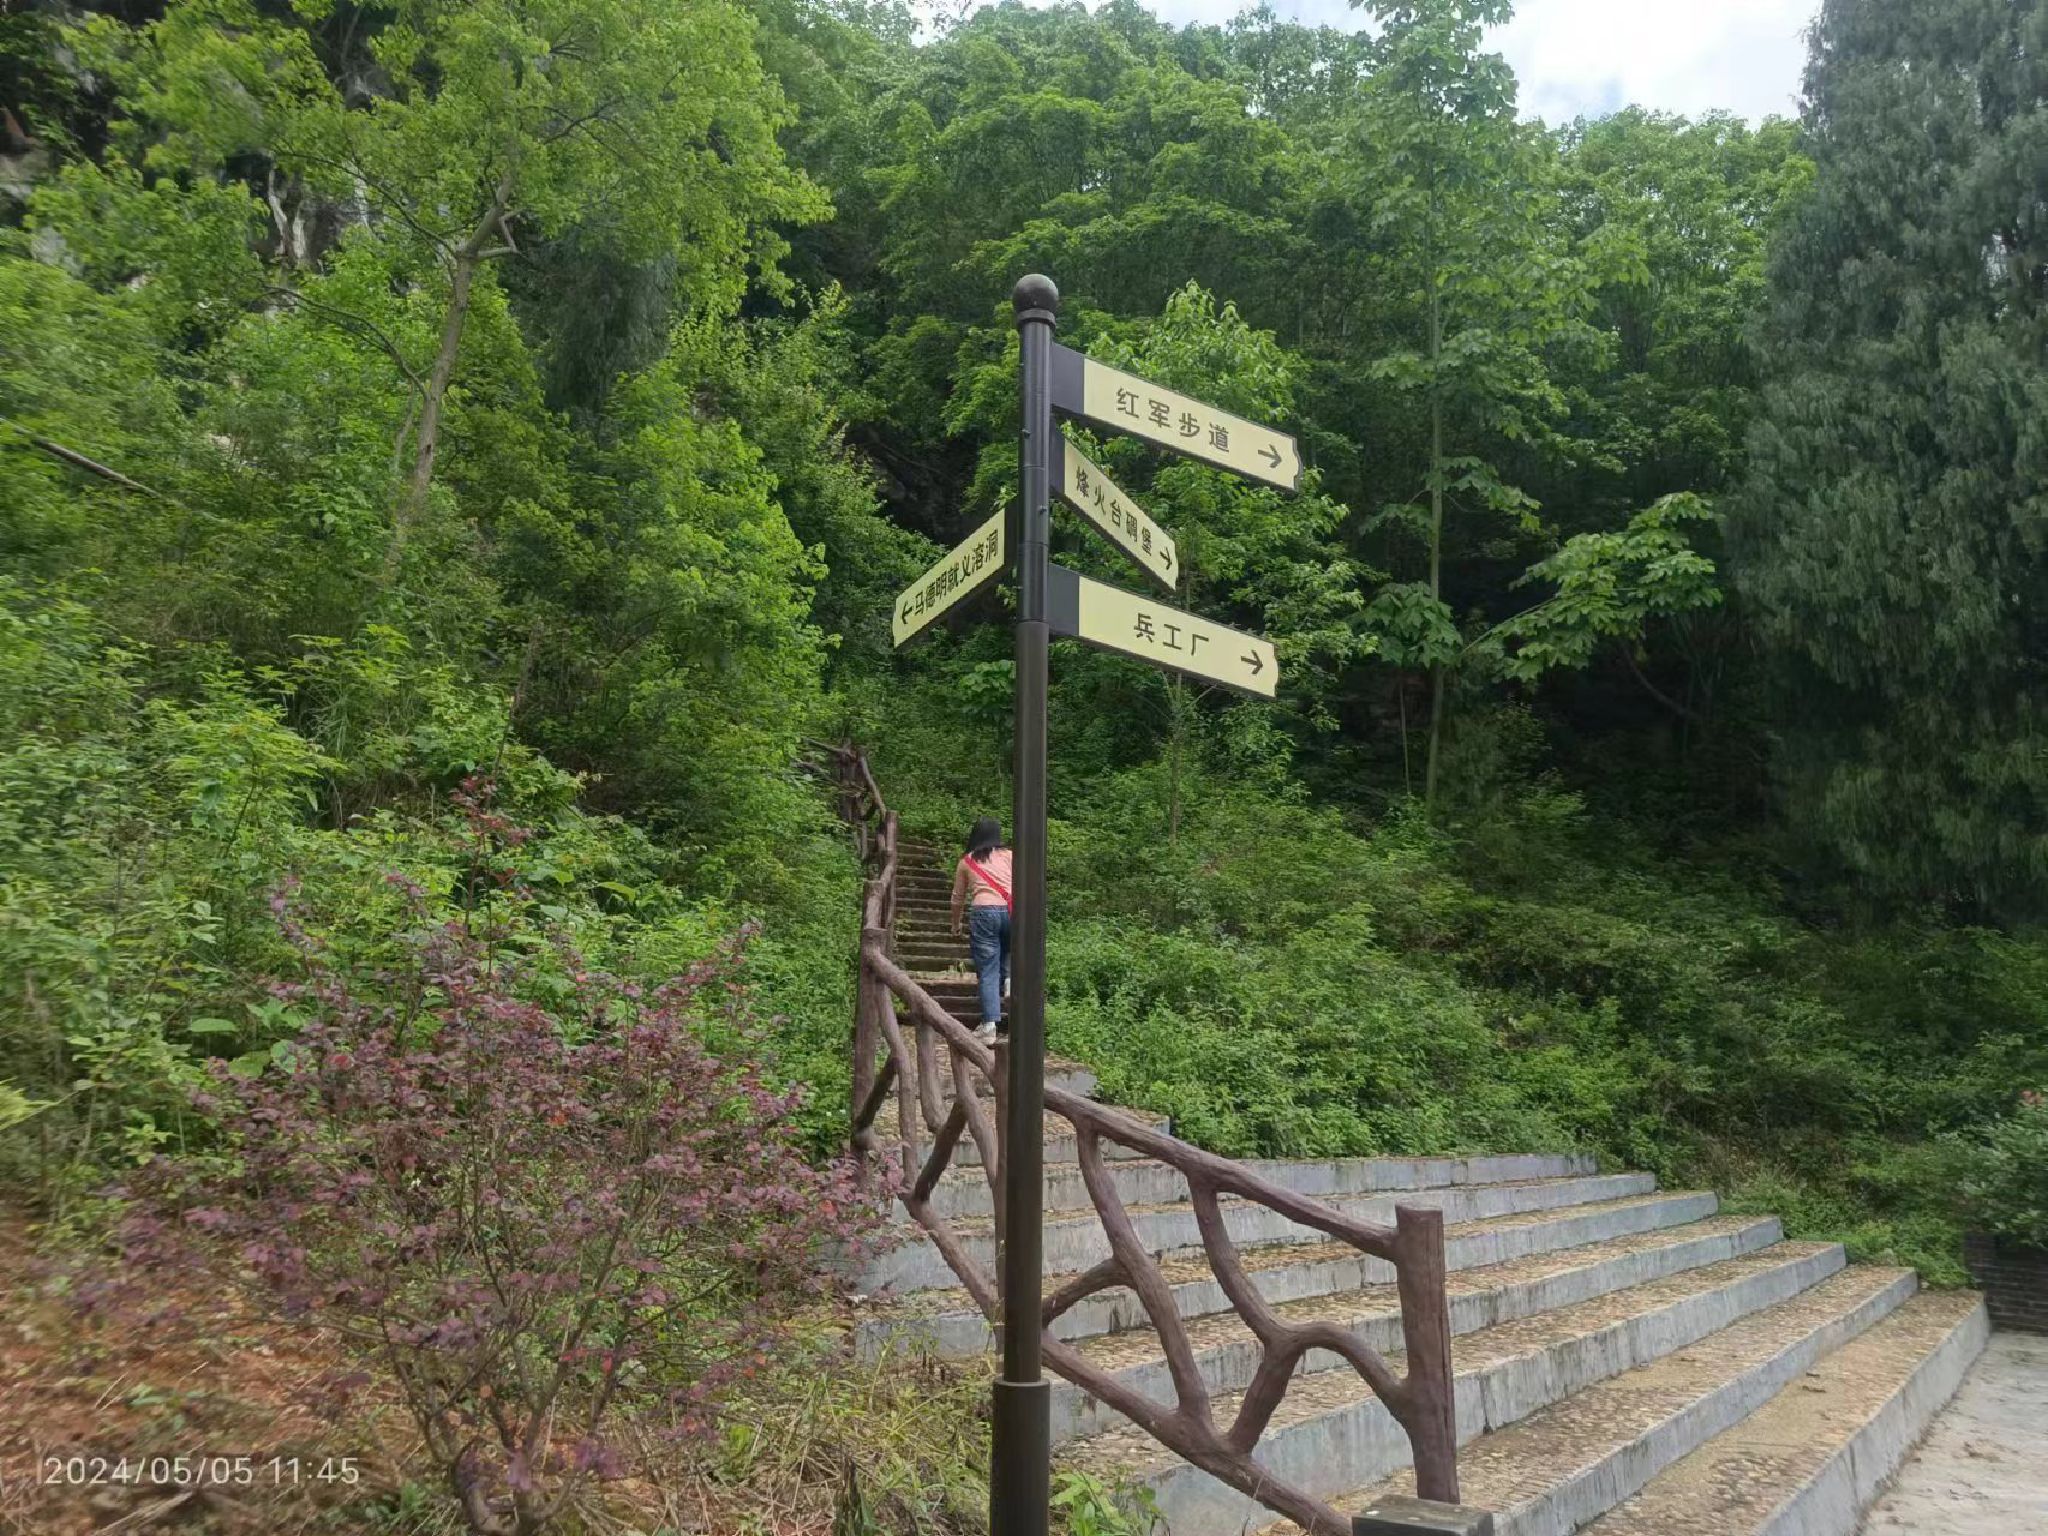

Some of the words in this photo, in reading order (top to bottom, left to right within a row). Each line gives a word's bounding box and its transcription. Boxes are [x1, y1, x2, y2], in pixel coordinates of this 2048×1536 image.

[1115, 387, 1230, 453] 红军步道
[1076, 465, 1152, 557] 烽火台碉堡
[1133, 612, 1210, 656] 兵工厂
